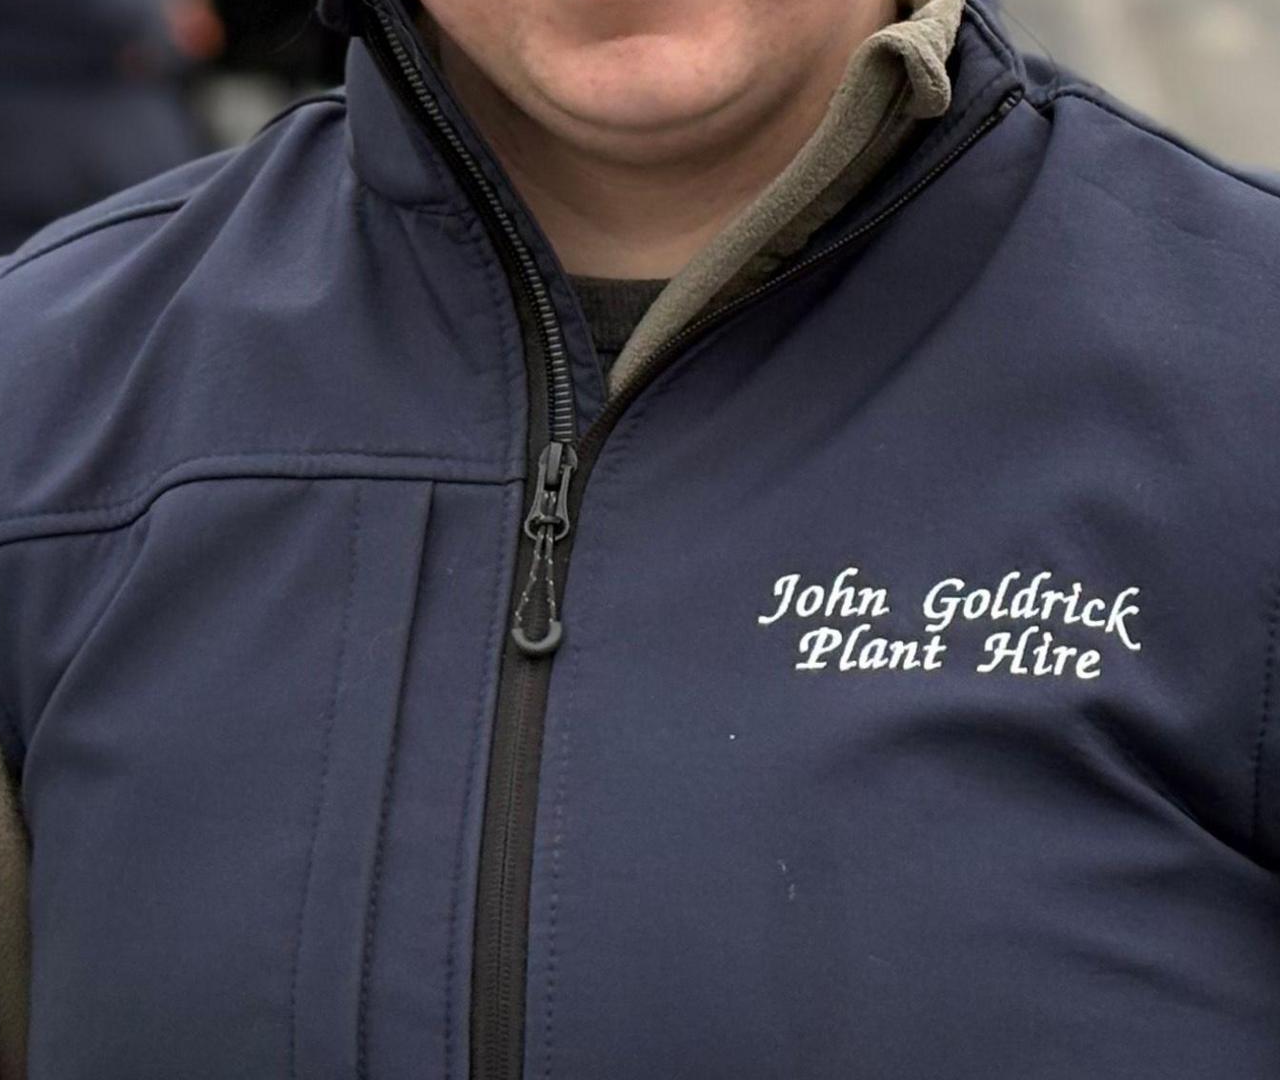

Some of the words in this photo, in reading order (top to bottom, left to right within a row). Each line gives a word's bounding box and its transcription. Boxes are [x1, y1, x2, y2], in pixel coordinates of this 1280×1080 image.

[758, 567, 889, 624] John
[923, 571, 1141, 650] Goldrick
[795, 623, 947, 671] Plant
[976, 626, 1101, 679] Hire
